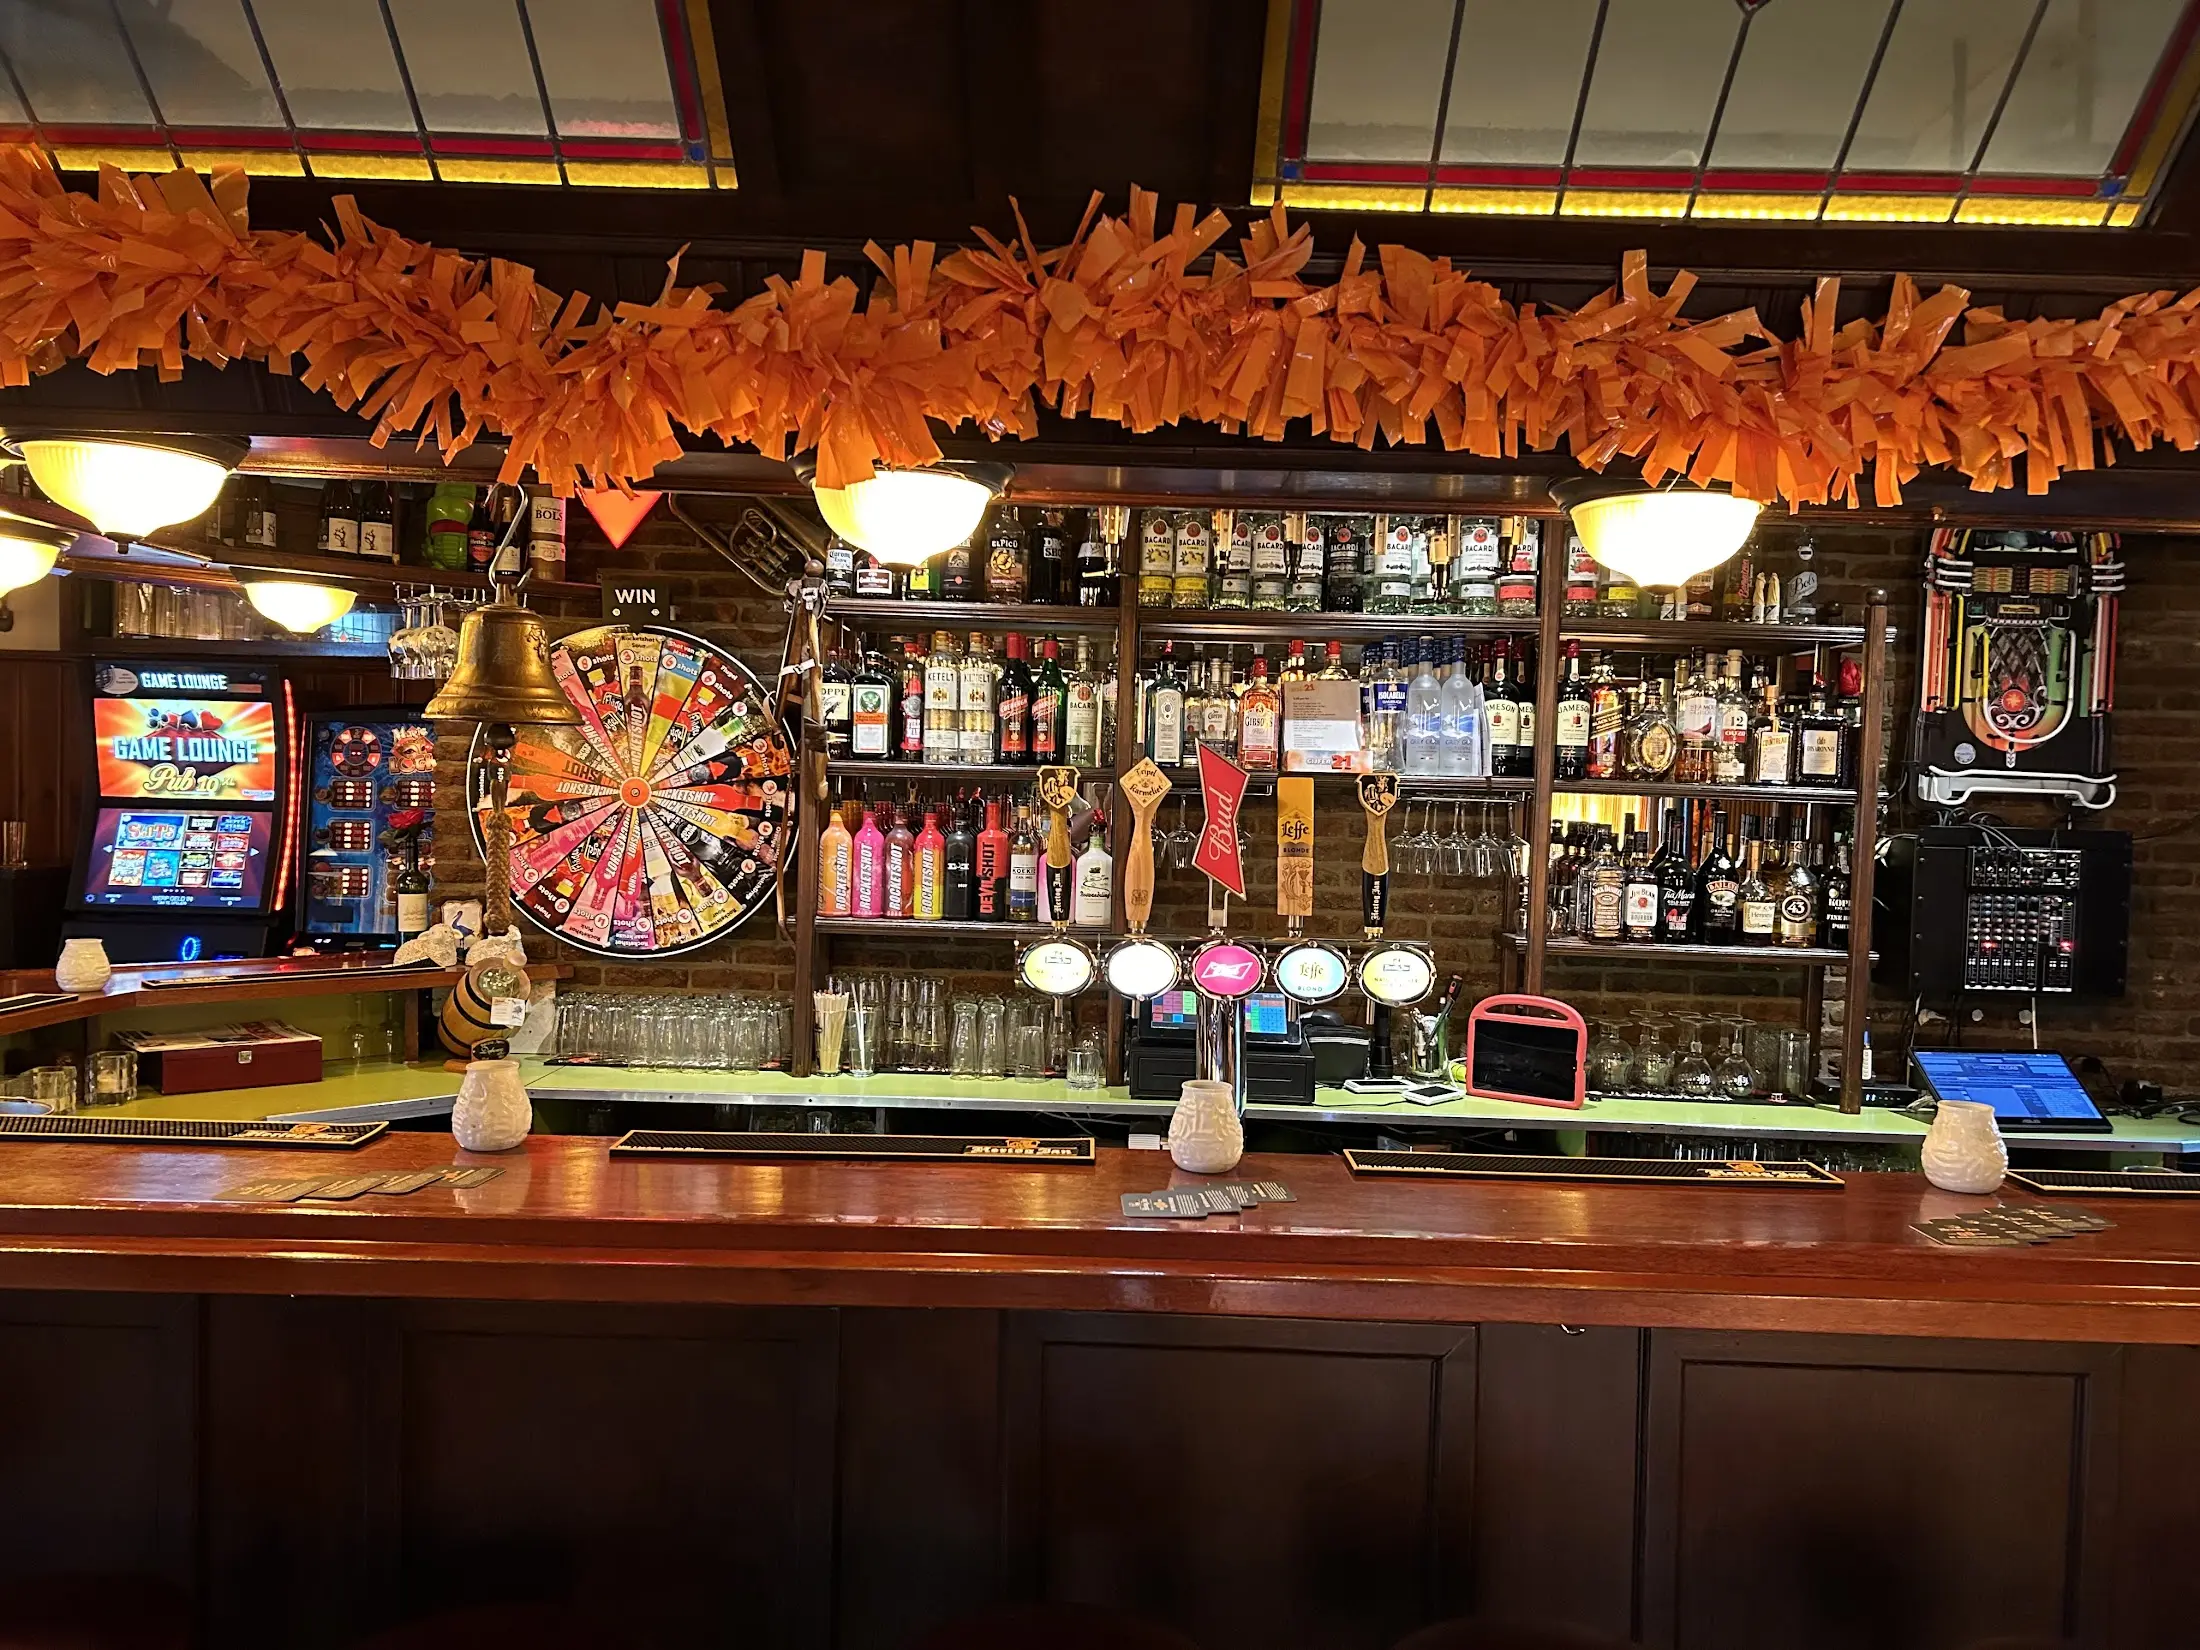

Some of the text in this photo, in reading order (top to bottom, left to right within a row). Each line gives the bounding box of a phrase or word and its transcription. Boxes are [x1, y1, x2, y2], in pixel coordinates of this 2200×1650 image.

[535, 509, 563, 521] BOLS
[1793, 574, 1816, 595] Bols
[615, 588, 656, 604] WIN
[592, 654, 614, 665] shots
[635, 654, 658, 662] shots
[677, 663, 698, 676] shots
[141, 672, 228, 690] GAME LOUNGE
[713, 682, 734, 700] shots
[1730, 717, 1743, 726] 12
[112, 737, 259, 763] GAME LOUNGE
[1331, 755, 1351, 770] 21
[143, 762, 196, 792] Pub
[197, 777, 220, 792] 10
[1134, 767, 1156, 778] Tripel
[1208, 786, 1233, 861] Bud
[1281, 820, 1310, 840] Leffe
[752, 836, 765, 857] shots
[728, 872, 745, 890] shots
[836, 843, 848, 911] ROCKETSHOT
[860, 843, 873, 912] ROCKETSHOT
[889, 843, 903, 911] ROCKETSHOT
[921, 848, 934, 915] ROCKETSHOT
[980, 842, 996, 914] DEVILSHOT
[537, 884, 558, 902] shots
[1664, 889, 1696, 900] Tia Maria
[1787, 902, 1805, 914] 43
[612, 919, 636, 928] shots
[181, 936, 199, 961] 0
[1298, 985, 1323, 993] BLOND
